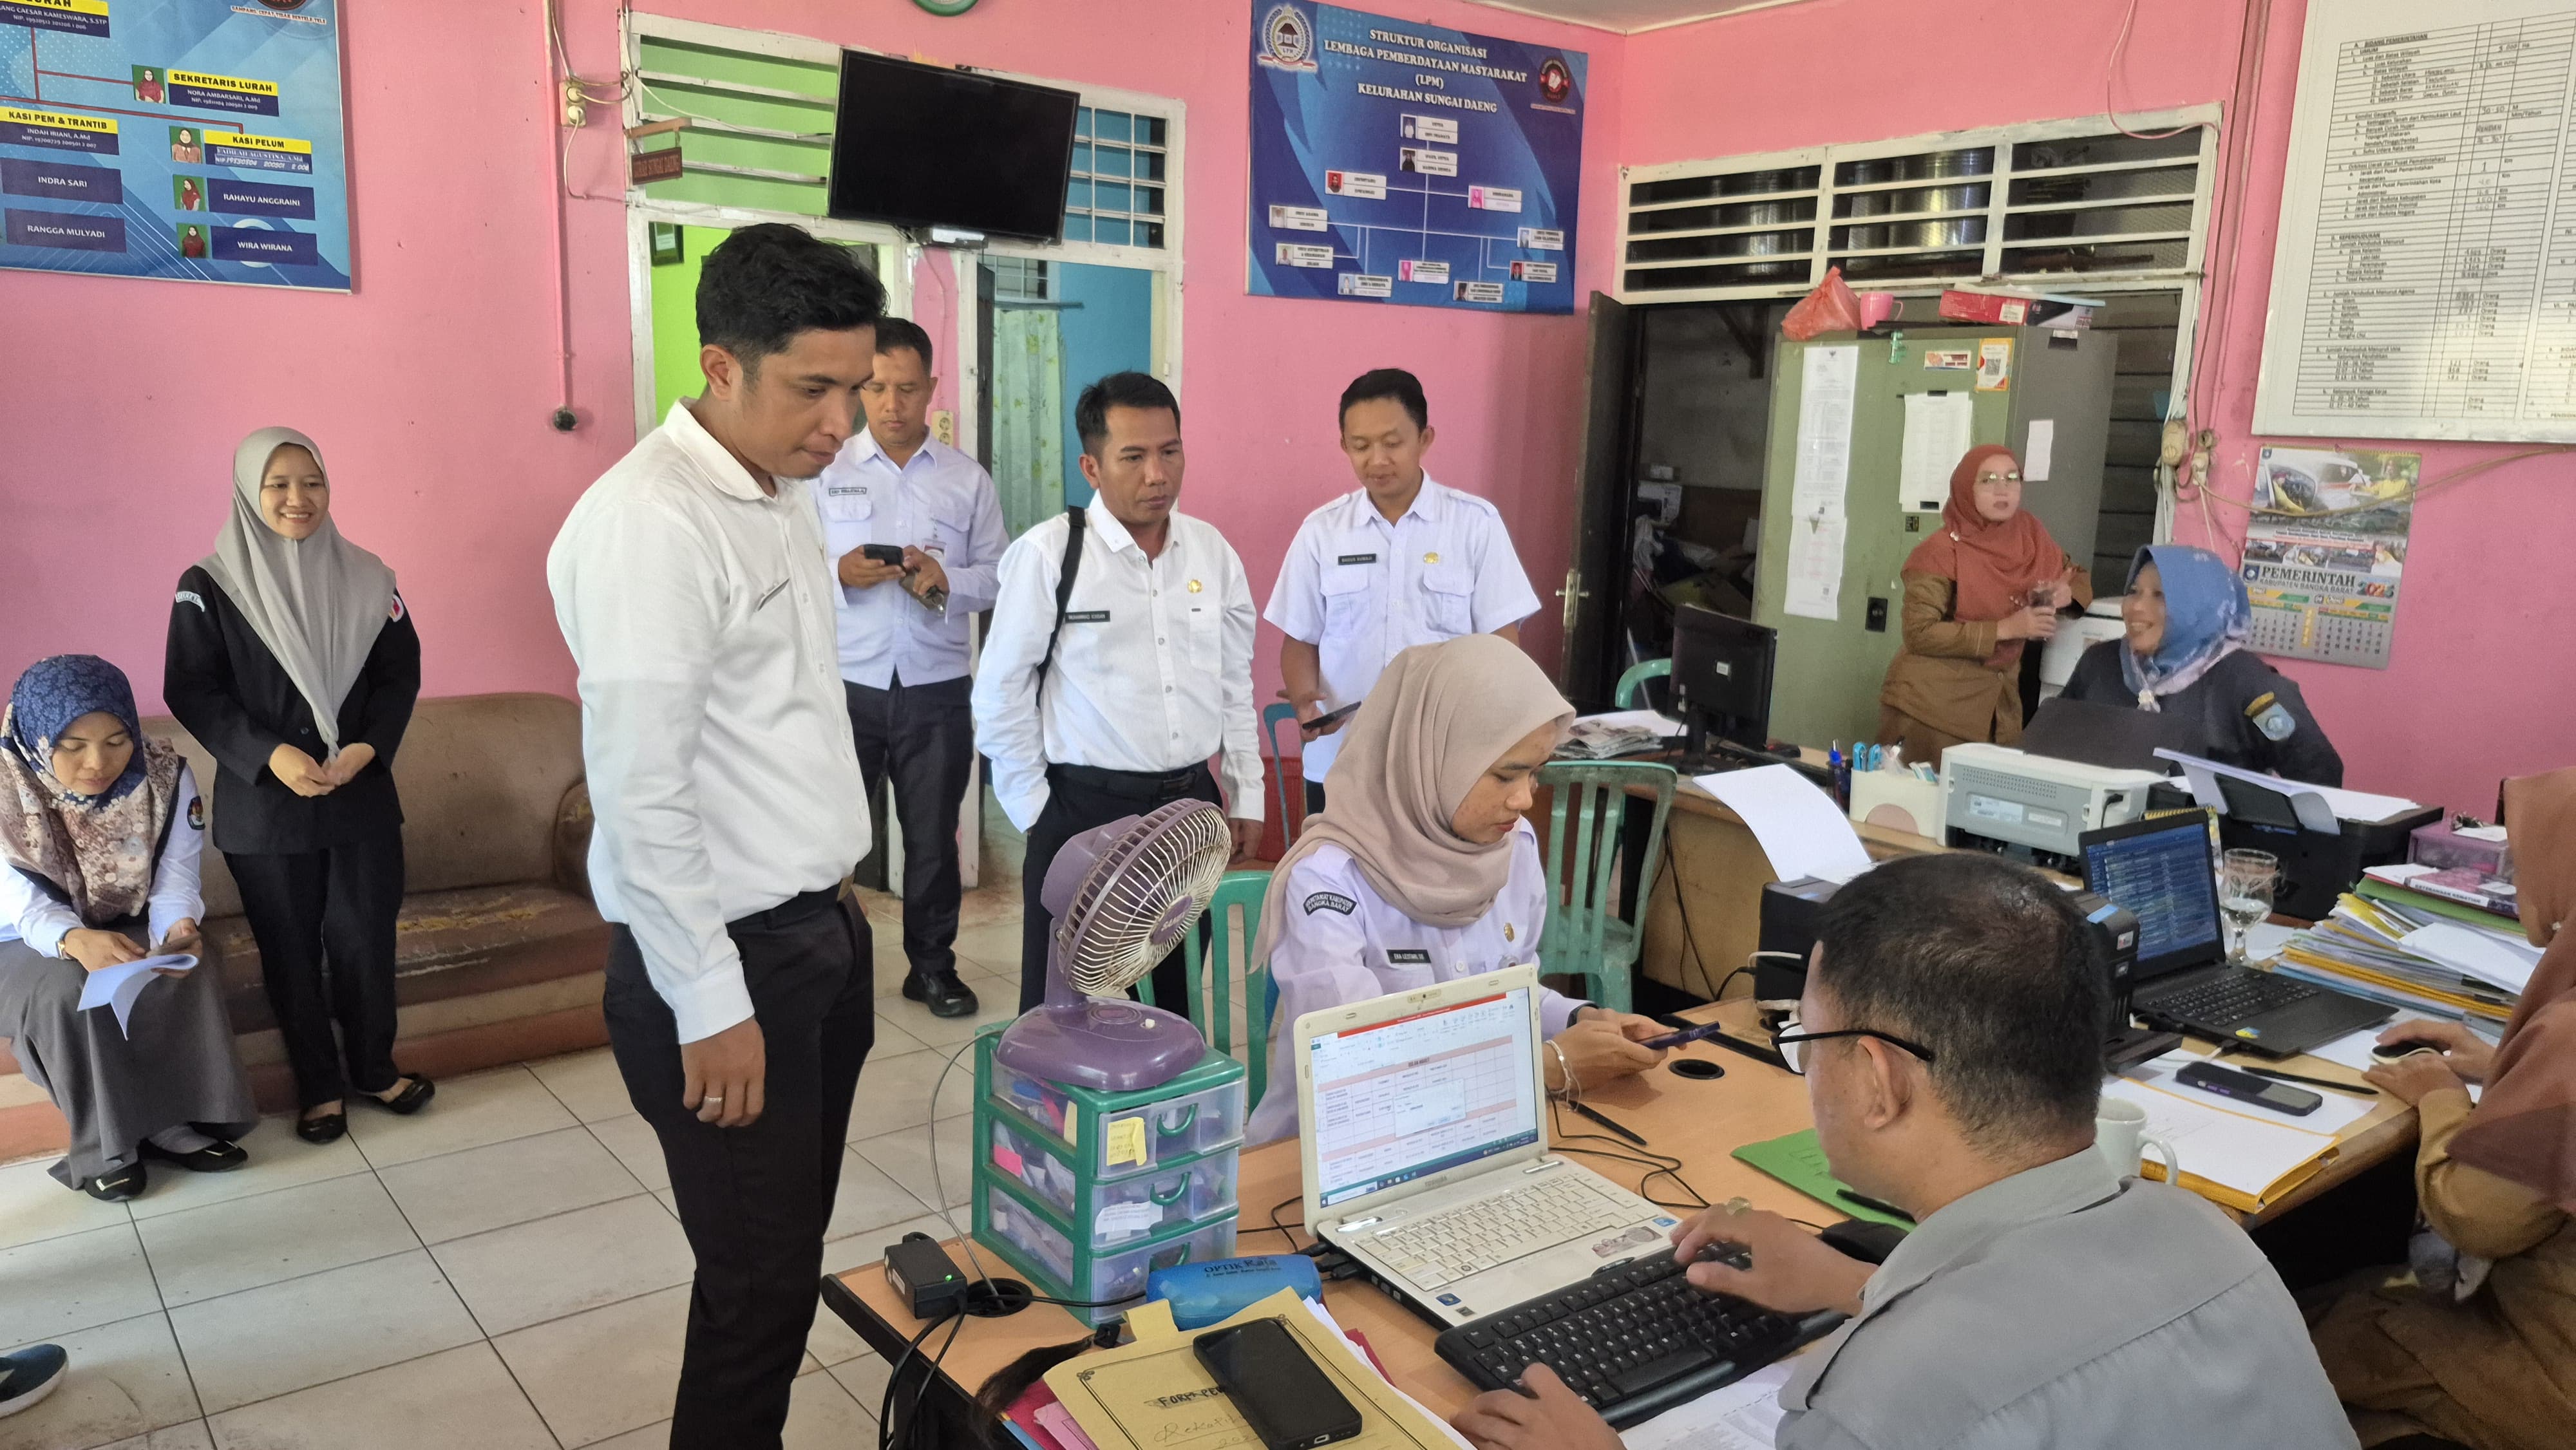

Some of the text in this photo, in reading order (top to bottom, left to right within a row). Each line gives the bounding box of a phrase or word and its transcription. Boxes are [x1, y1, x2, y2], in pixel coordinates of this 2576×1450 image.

[17, 7, 43, 15] CAESAR
[1370, 30, 1487, 59] STRUKTUR ORGANISASI
[1324, 39, 1528, 82] LEMBAGA PEMBERDAYAAN MASYARAKAT
[174, 73, 272, 92] SEKRETARIS LURAH
[1415, 74, 1444, 89] (LPM)
[1358, 83, 1497, 113] KELURAHAN SUNGAI DAENG
[9, 111, 32, 121] KASI
[35, 114, 55, 123] PEM
[68, 118, 108, 129] TRANTIB
[232, 136, 285, 148] KASI PELUM
[38, 176, 87, 187] INDRA SARI
[223, 193, 300, 206] RAHAYU ANGGRAINI
[27, 225, 105, 238] RANGGA MULYADI
[260, 243, 292, 252] WIRANA
[2262, 565, 2356, 587] PEMERINTAH
[2260, 578, 2298, 588] KABUPATEN
[2300, 583, 2329, 592] BANGKA
[2330, 585, 2353, 594] BARAT
[1204, 1263, 1244, 1272] OPTIK
[1157, 1391, 1196, 1407] FORM
